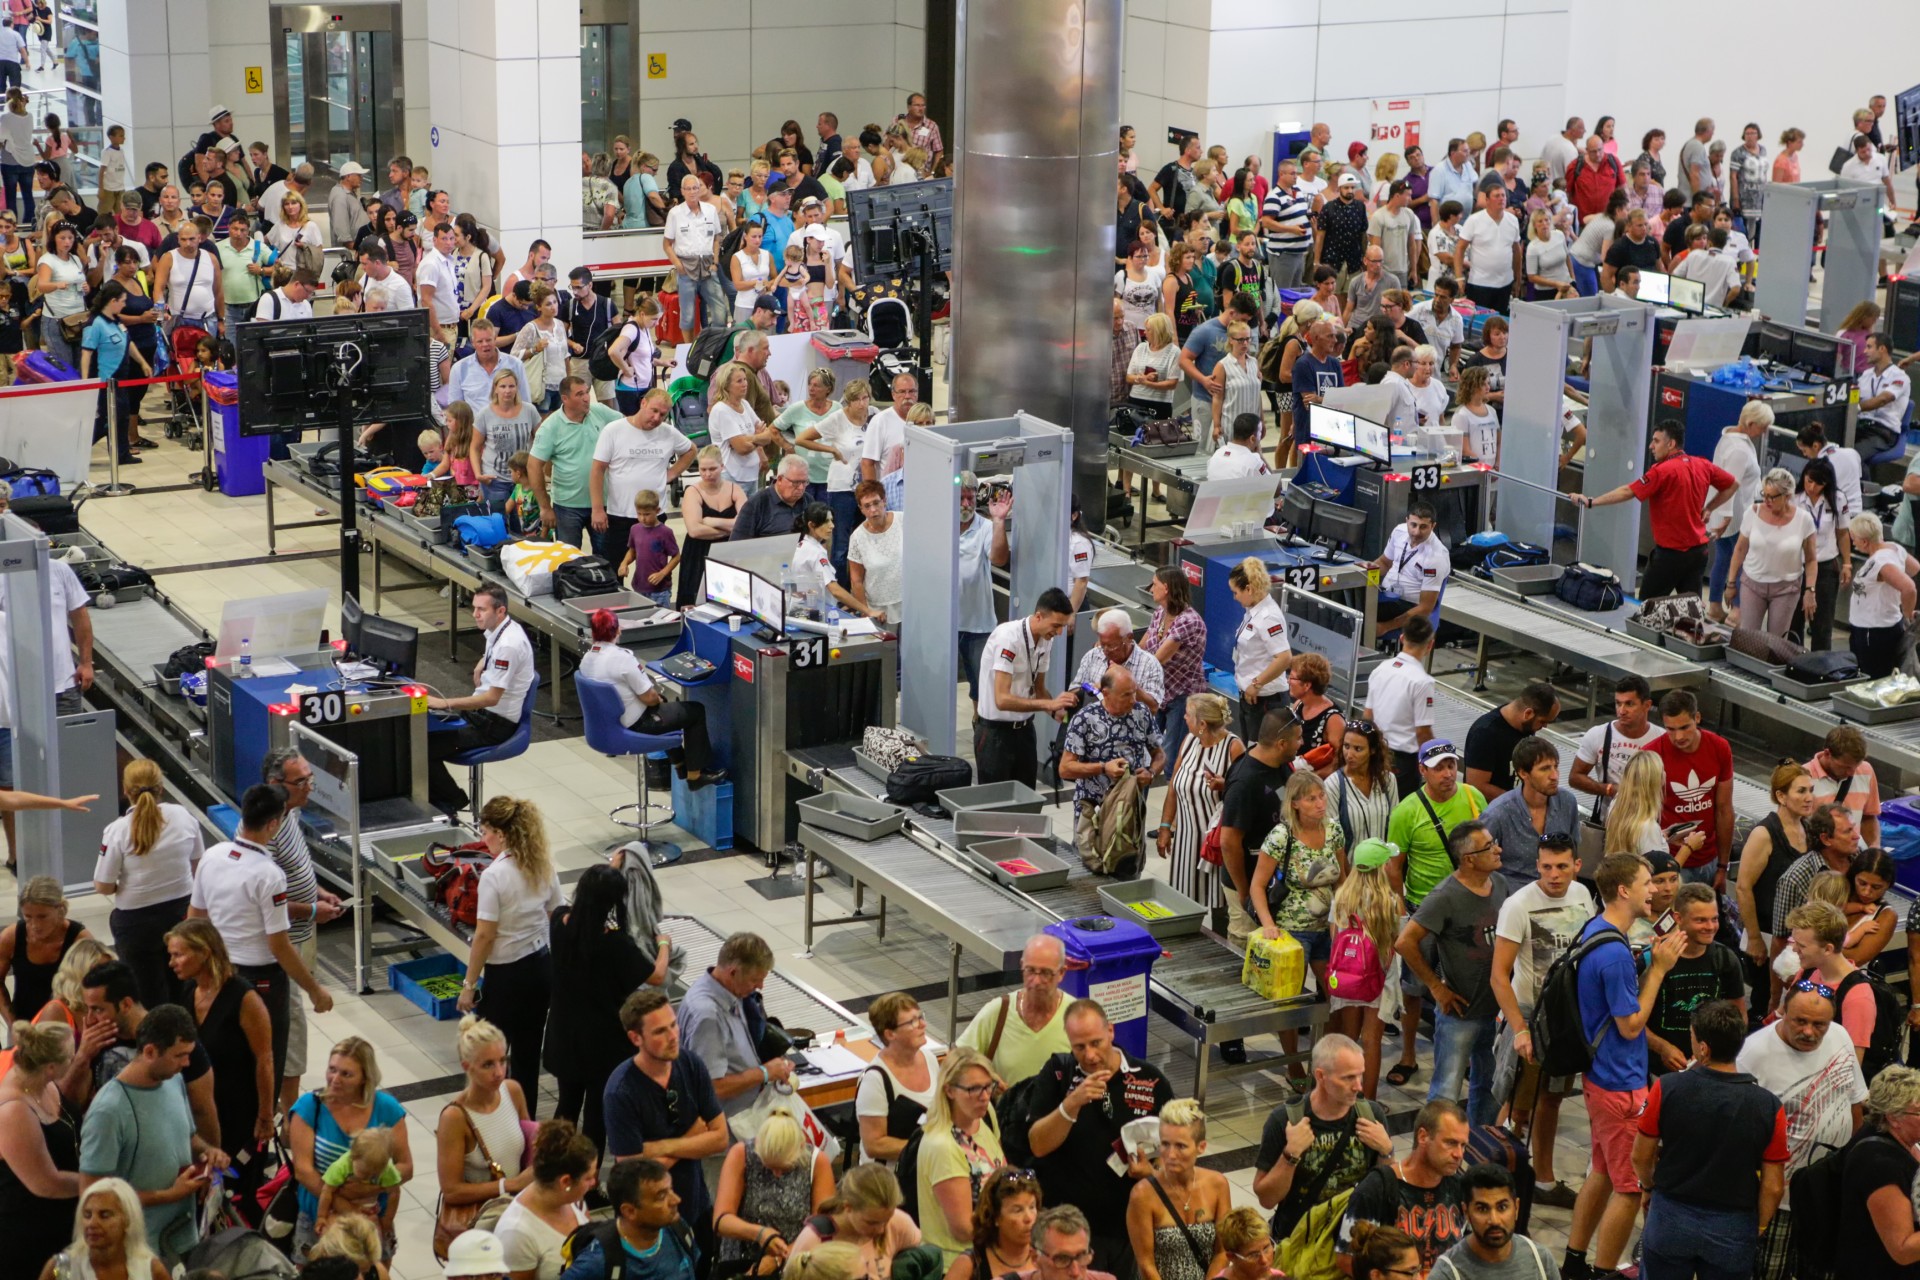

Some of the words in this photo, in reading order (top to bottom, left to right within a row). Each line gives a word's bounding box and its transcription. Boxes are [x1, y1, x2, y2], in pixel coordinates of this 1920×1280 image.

[1825, 383, 1848, 405] 34
[1413, 466, 1439, 490] 33
[1289, 567, 1316, 592] 32
[795, 639, 823, 668] 31
[304, 693, 342, 725] 30
[1674, 799, 1713, 814] adidas
